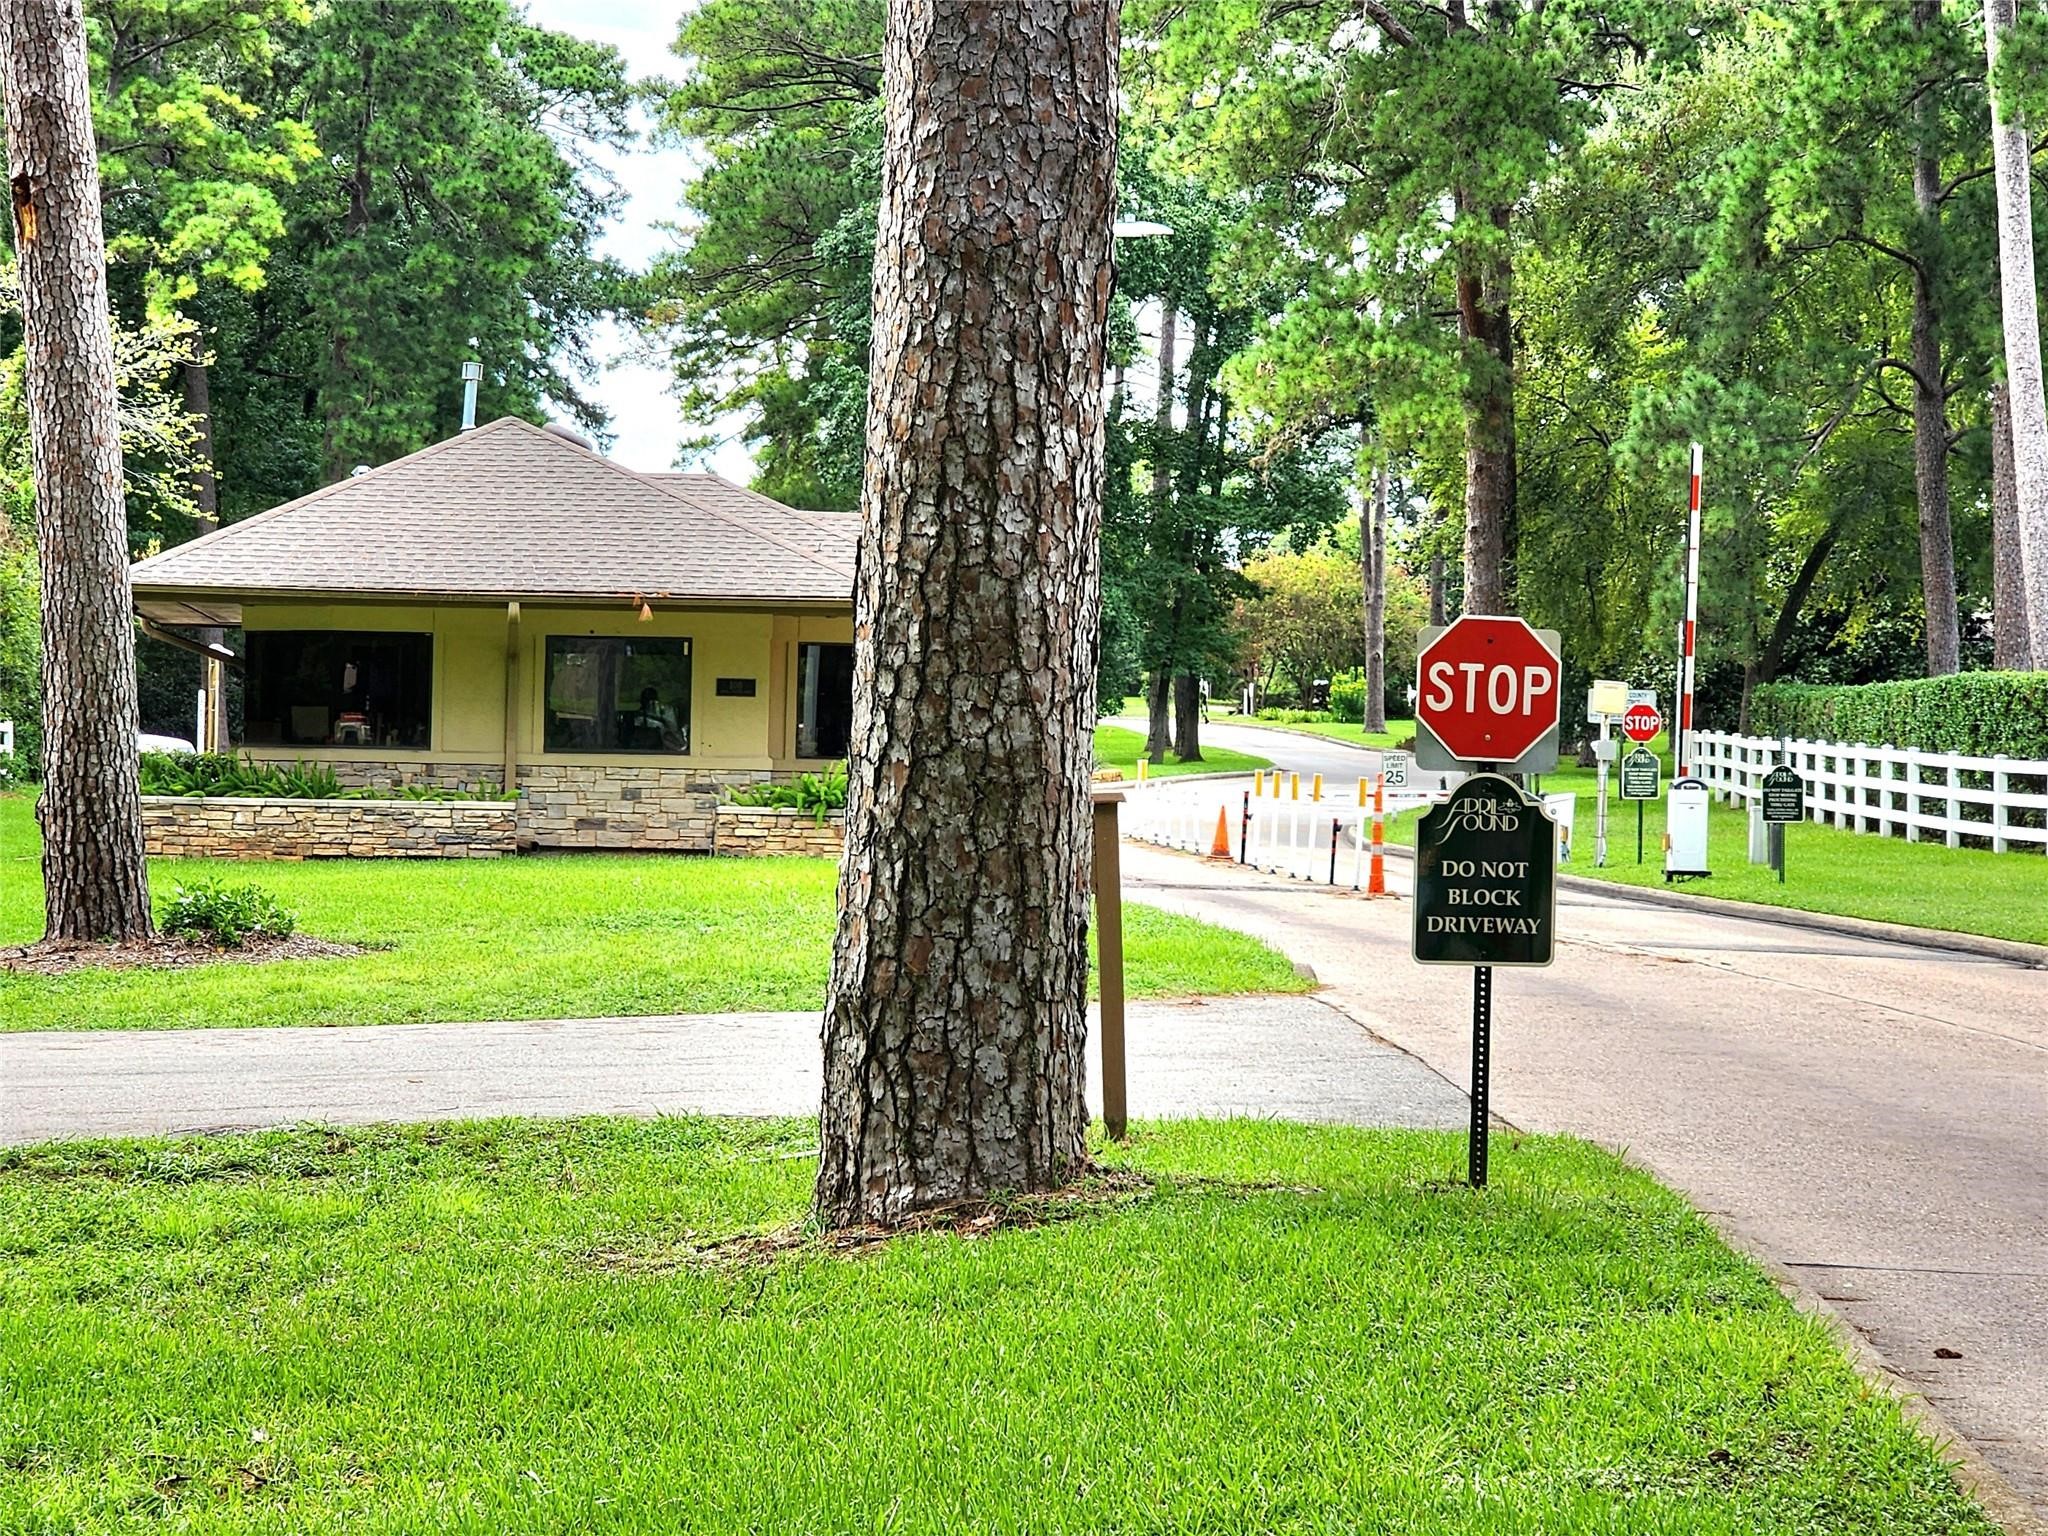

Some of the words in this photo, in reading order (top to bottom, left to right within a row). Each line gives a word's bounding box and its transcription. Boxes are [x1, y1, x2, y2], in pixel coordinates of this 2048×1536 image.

[1426, 661, 1552, 716] STOP
[1625, 715, 1660, 731] STOP
[1385, 770, 1404, 784] 25
[1435, 798, 1505, 830] APRIL
[1435, 814, 1519, 845] SOUND
[1441, 860, 1475, 877] DO
[1480, 861, 1529, 878] NOT
[1447, 888, 1521, 906] BLOCK
[1426, 916, 1541, 935] DRIVEWAY
